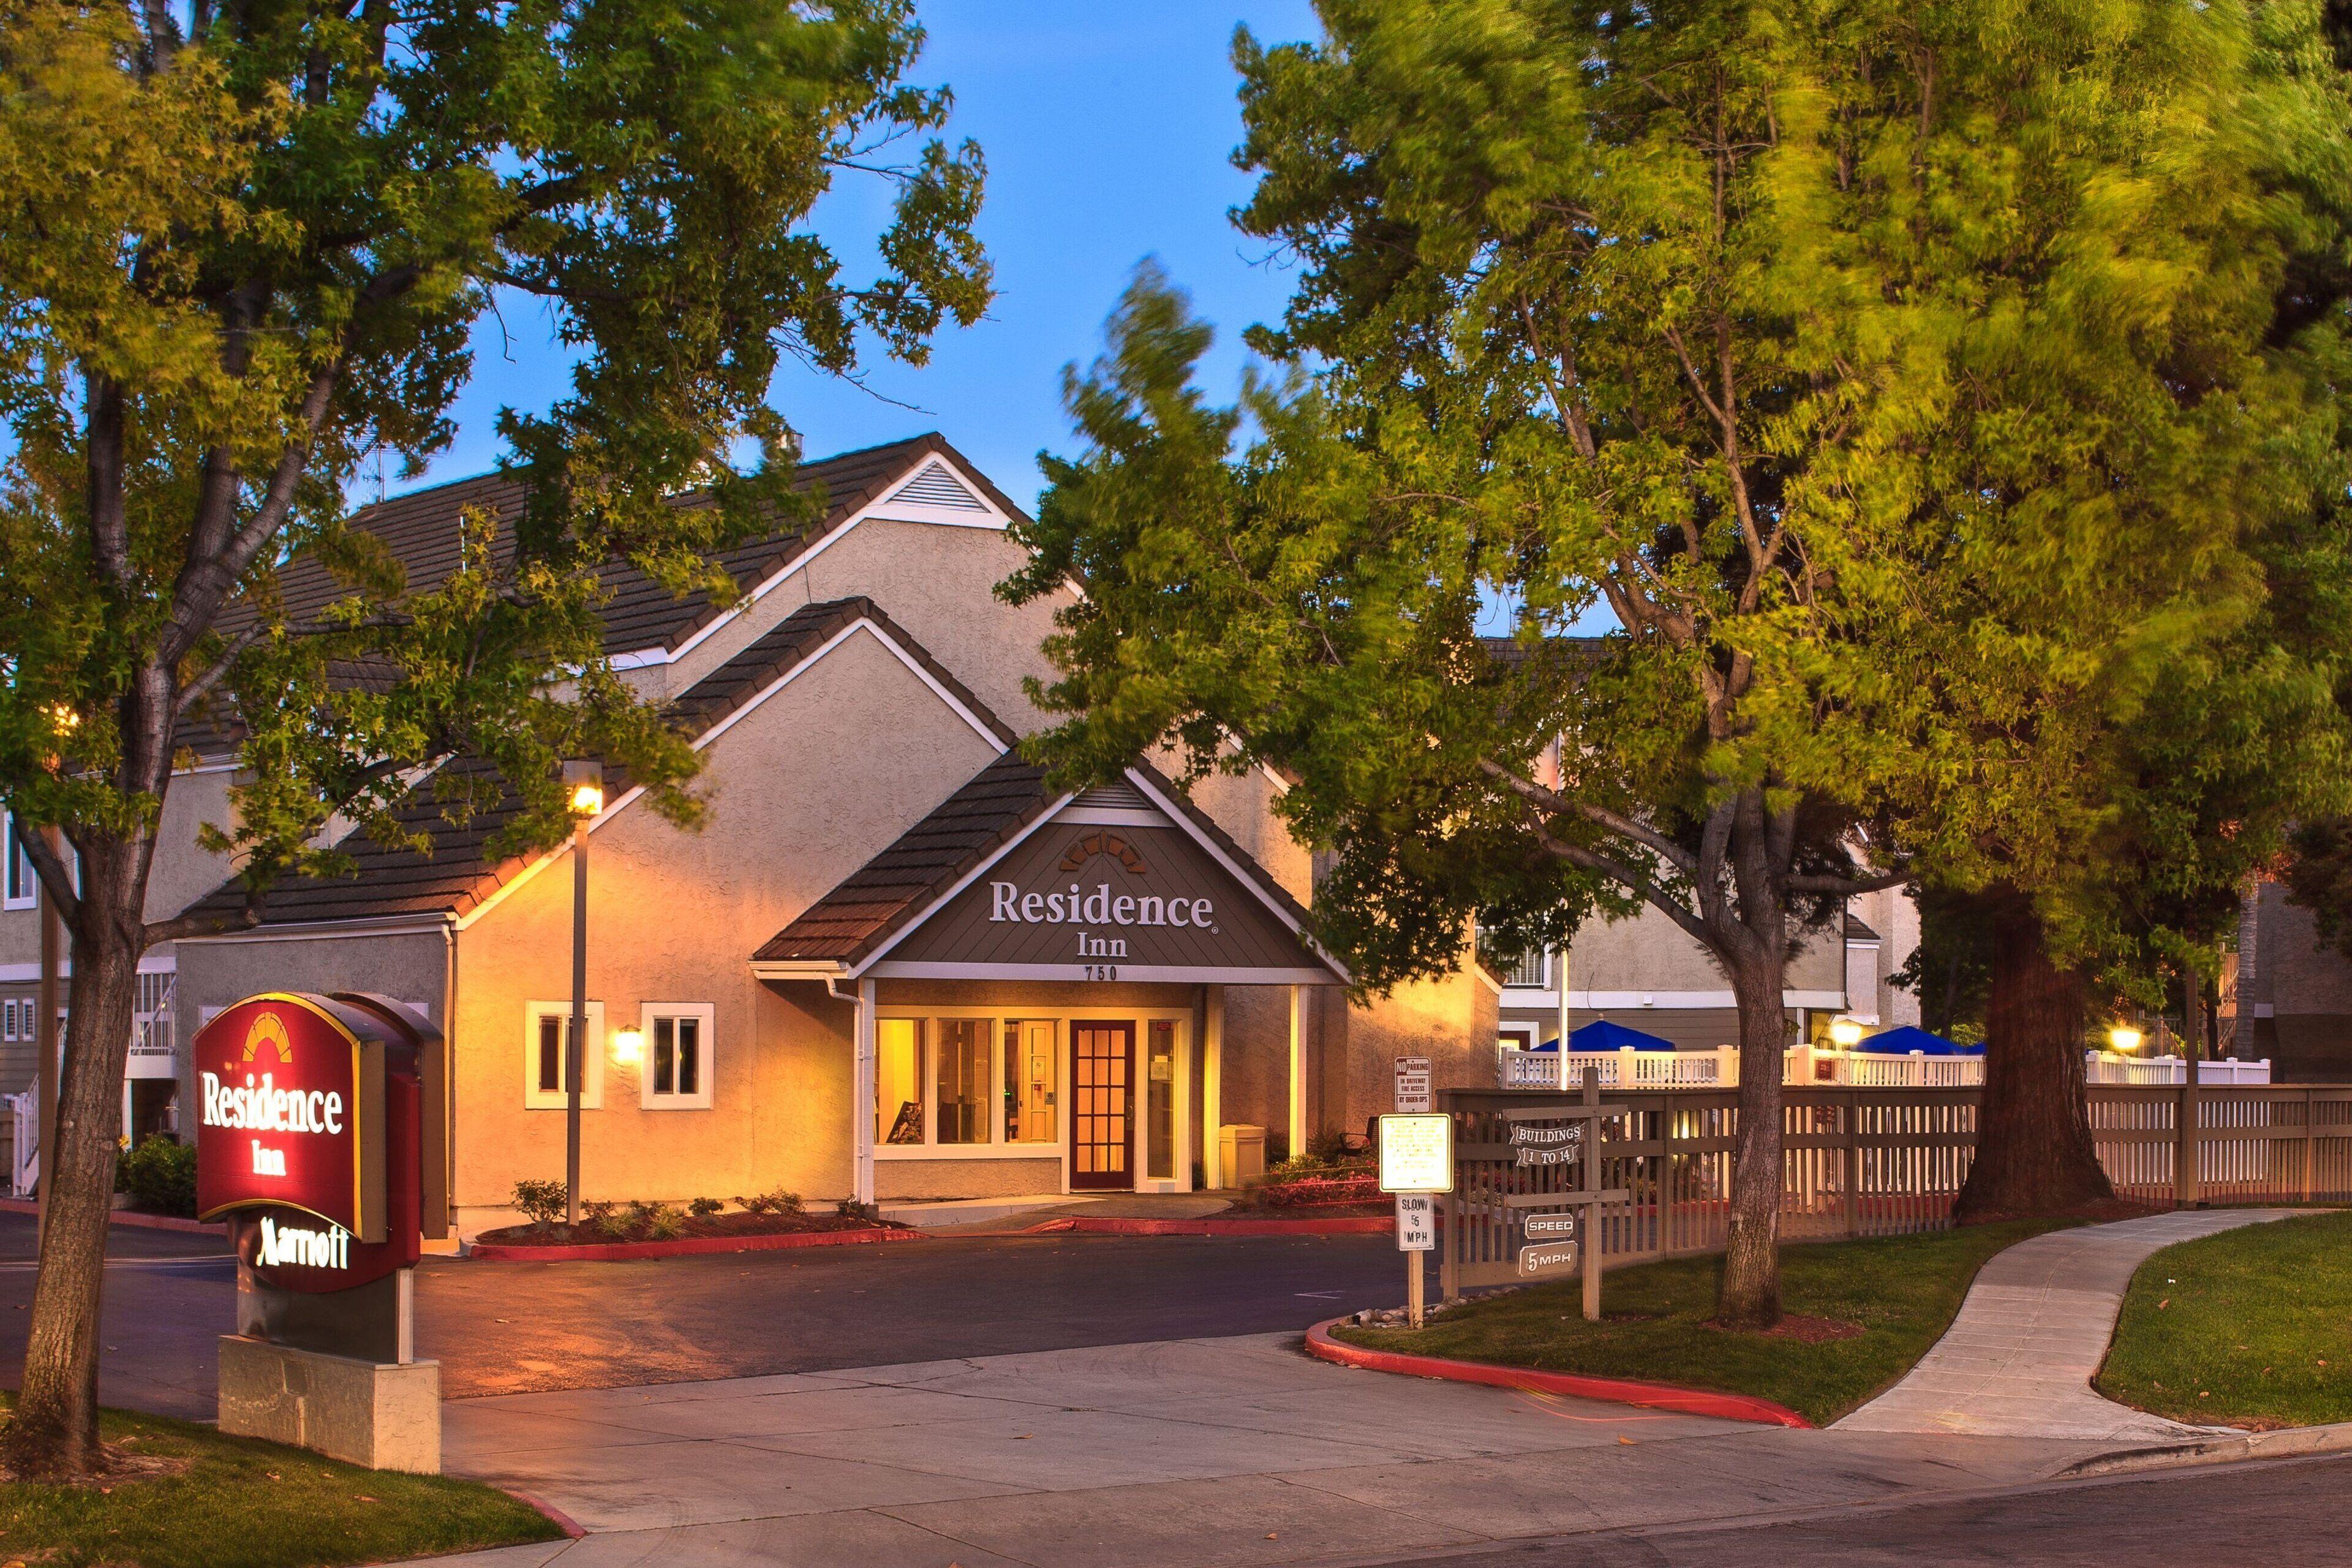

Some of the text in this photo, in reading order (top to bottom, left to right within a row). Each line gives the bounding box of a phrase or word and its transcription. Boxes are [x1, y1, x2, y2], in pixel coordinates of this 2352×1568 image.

[989, 881, 1213, 928] Residence
[1077, 932, 1128, 957] Inn
[1085, 965, 1117, 981] 750
[1396, 1061, 1406, 1072] NO
[202, 1072, 343, 1134] Residence
[1518, 1126, 1581, 1143] BUILDINGS
[252, 1140, 287, 1176] Inn
[1528, 1149, 1570, 1164] 1 TO 14
[1401, 1199, 1428, 1211] SLOW
[1529, 1221, 1573, 1231] SPEED
[255, 1216, 349, 1270] Marriott
[1407, 1231, 1428, 1243] MPH
[1528, 1252, 1571, 1272] 5 MPH
